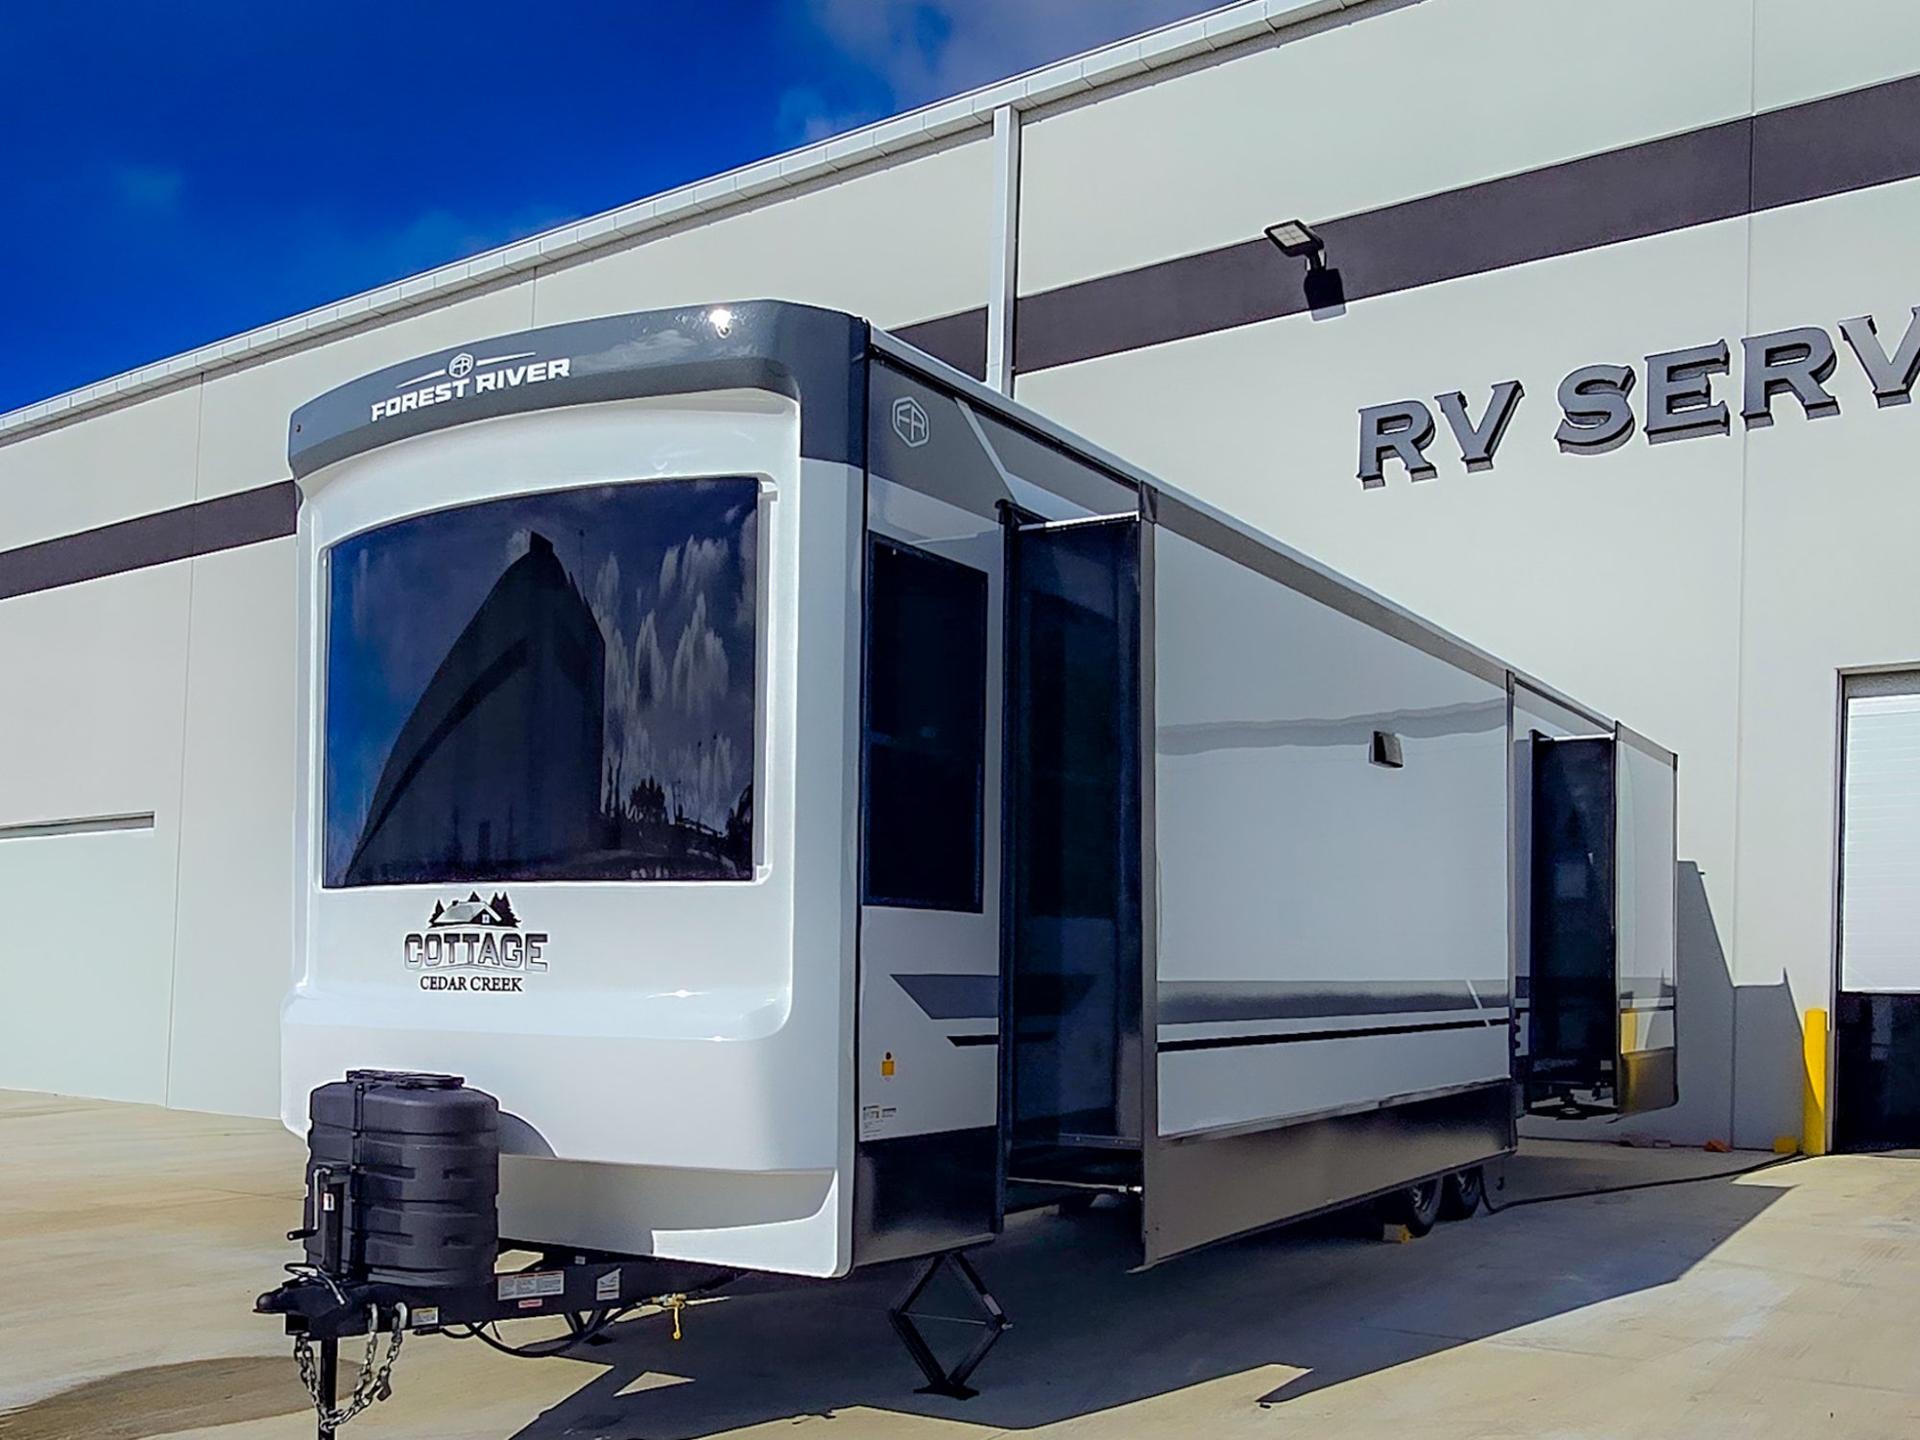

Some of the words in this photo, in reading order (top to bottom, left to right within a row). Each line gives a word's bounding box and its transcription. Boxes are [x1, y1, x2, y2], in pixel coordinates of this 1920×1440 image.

[370, 378, 471, 423] FOREST
[475, 358, 571, 394] RIVER
[1356, 379, 1525, 490] RV
[404, 932, 549, 973] COTTAGE
[420, 975, 467, 991] CEDAR
[470, 976, 523, 992] CREEK
